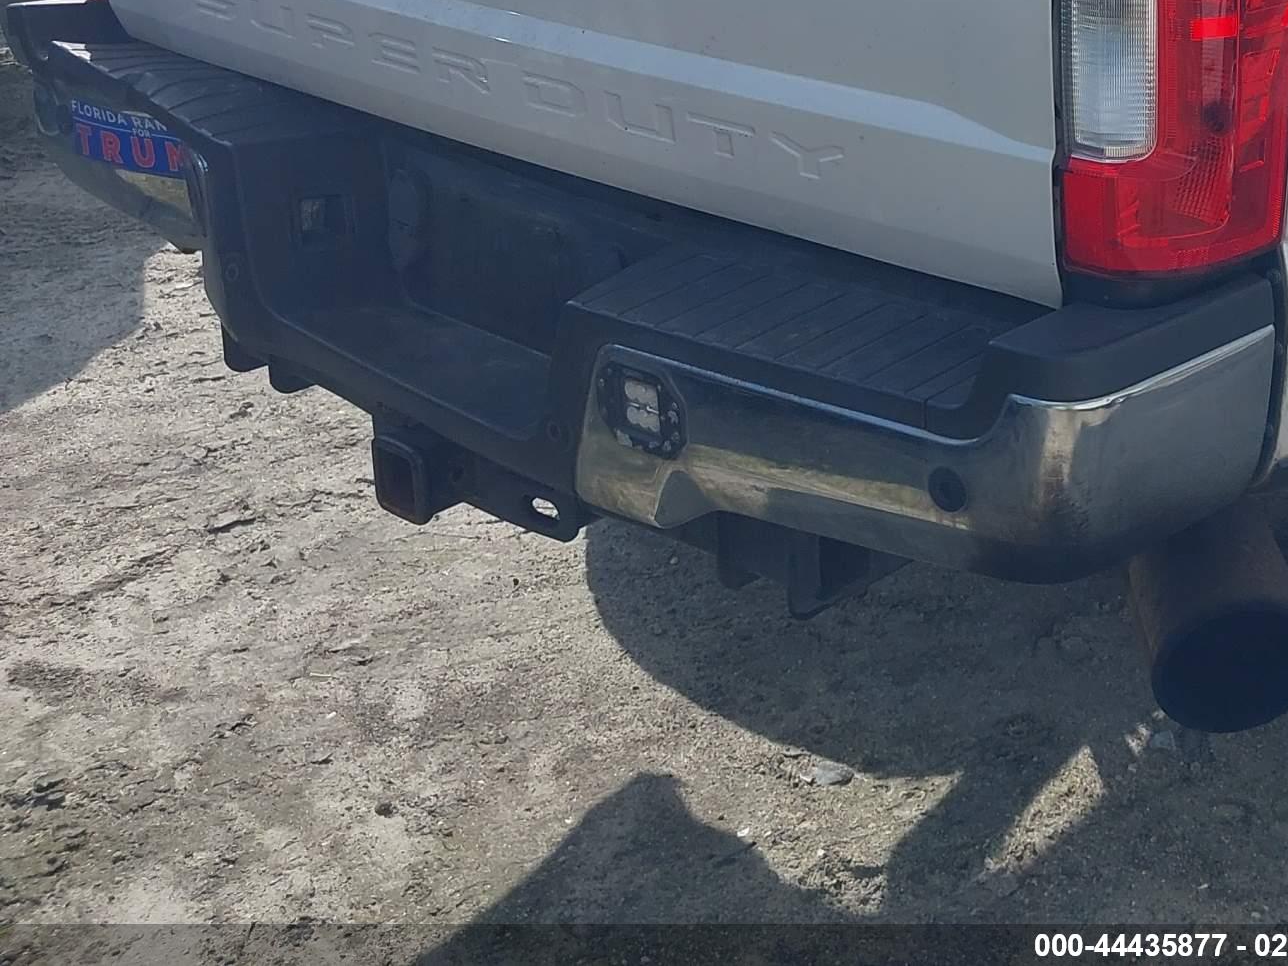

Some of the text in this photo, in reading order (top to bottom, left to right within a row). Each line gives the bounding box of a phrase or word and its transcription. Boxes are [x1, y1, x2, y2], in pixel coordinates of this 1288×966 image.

[71, 99, 128, 126] FLORIDA
[522, 69, 846, 180] DUTY
[132, 128, 152, 139] FOR
